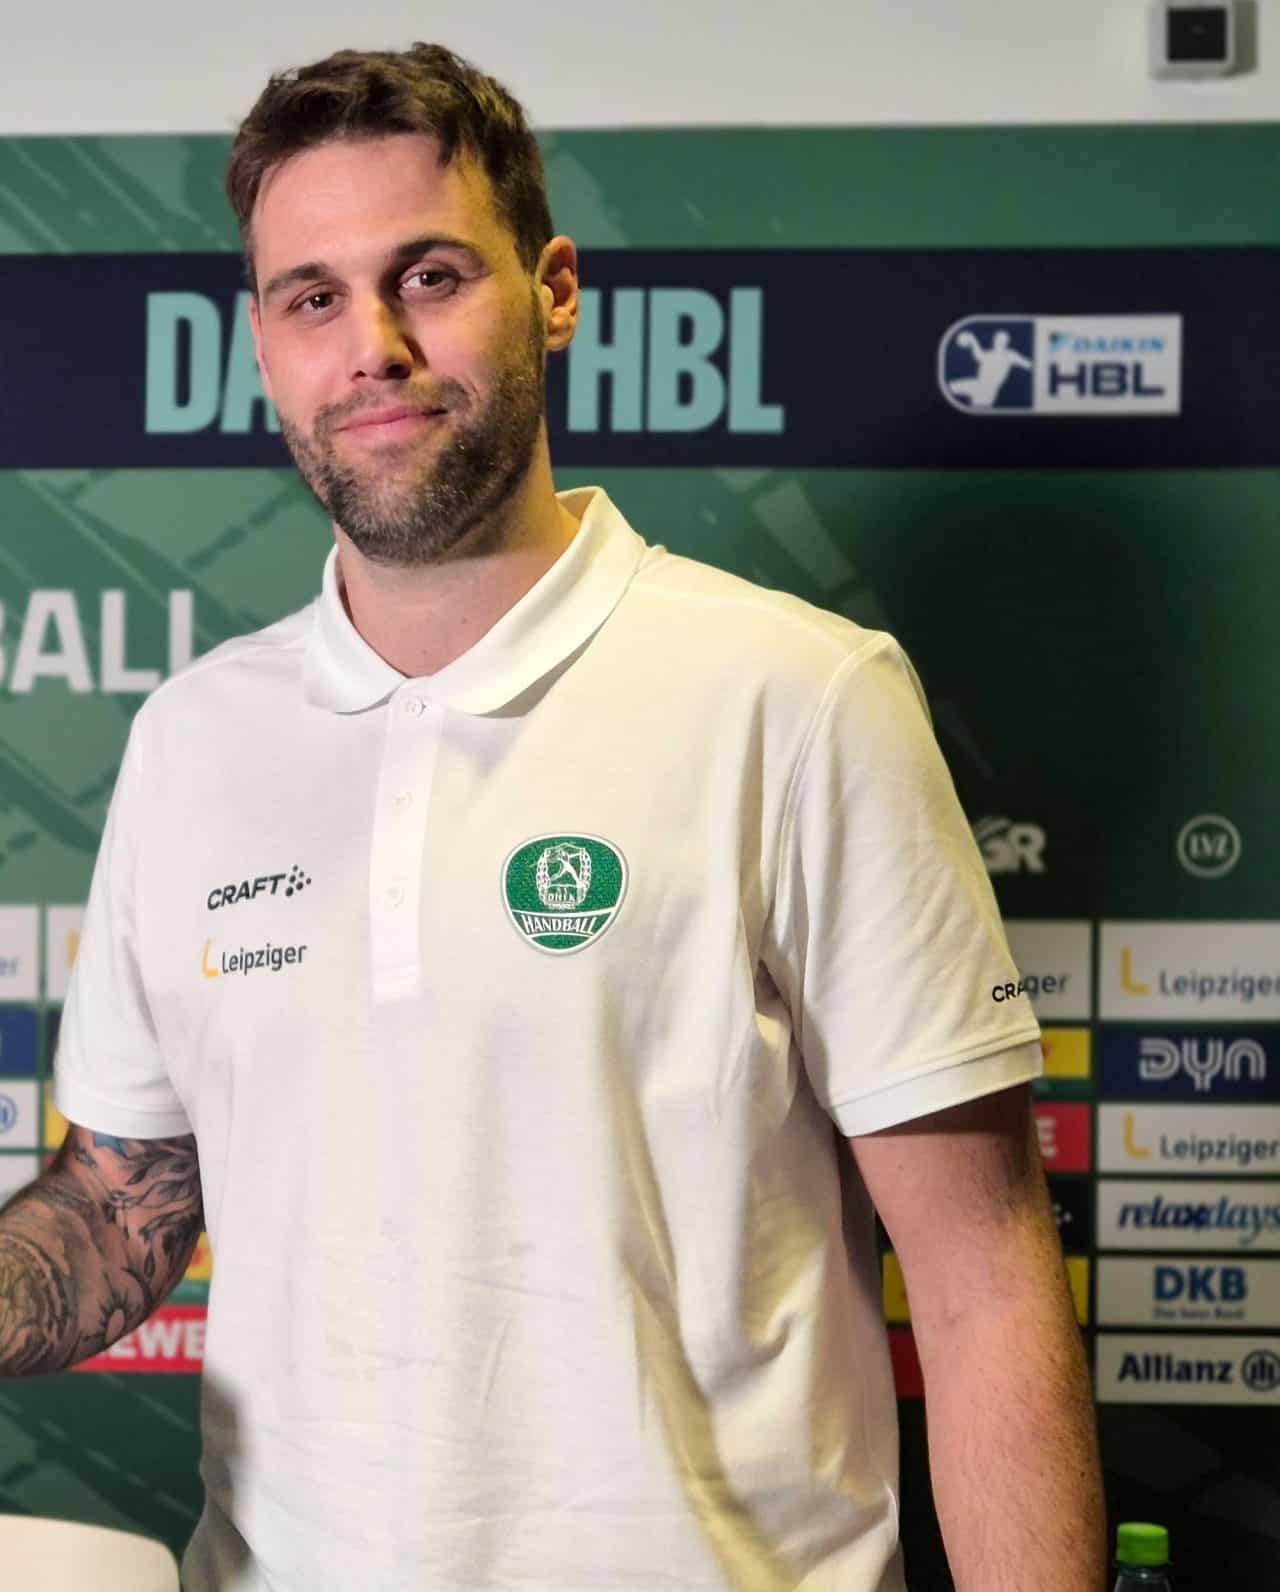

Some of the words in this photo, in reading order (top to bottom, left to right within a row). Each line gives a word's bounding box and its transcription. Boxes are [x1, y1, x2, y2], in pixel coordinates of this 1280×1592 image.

[568, 287, 785, 433] HBL
[1048, 361, 1166, 397] HBL
[206, 873, 287, 911] CRAFT
[520, 912, 598, 935] HANDBALL
[222, 943, 308, 977] Leipziger
[1159, 1133, 1279, 1168] Leipziger
[1153, 1265, 1247, 1302] DKB
[1118, 1352, 1235, 1385] Allianz
